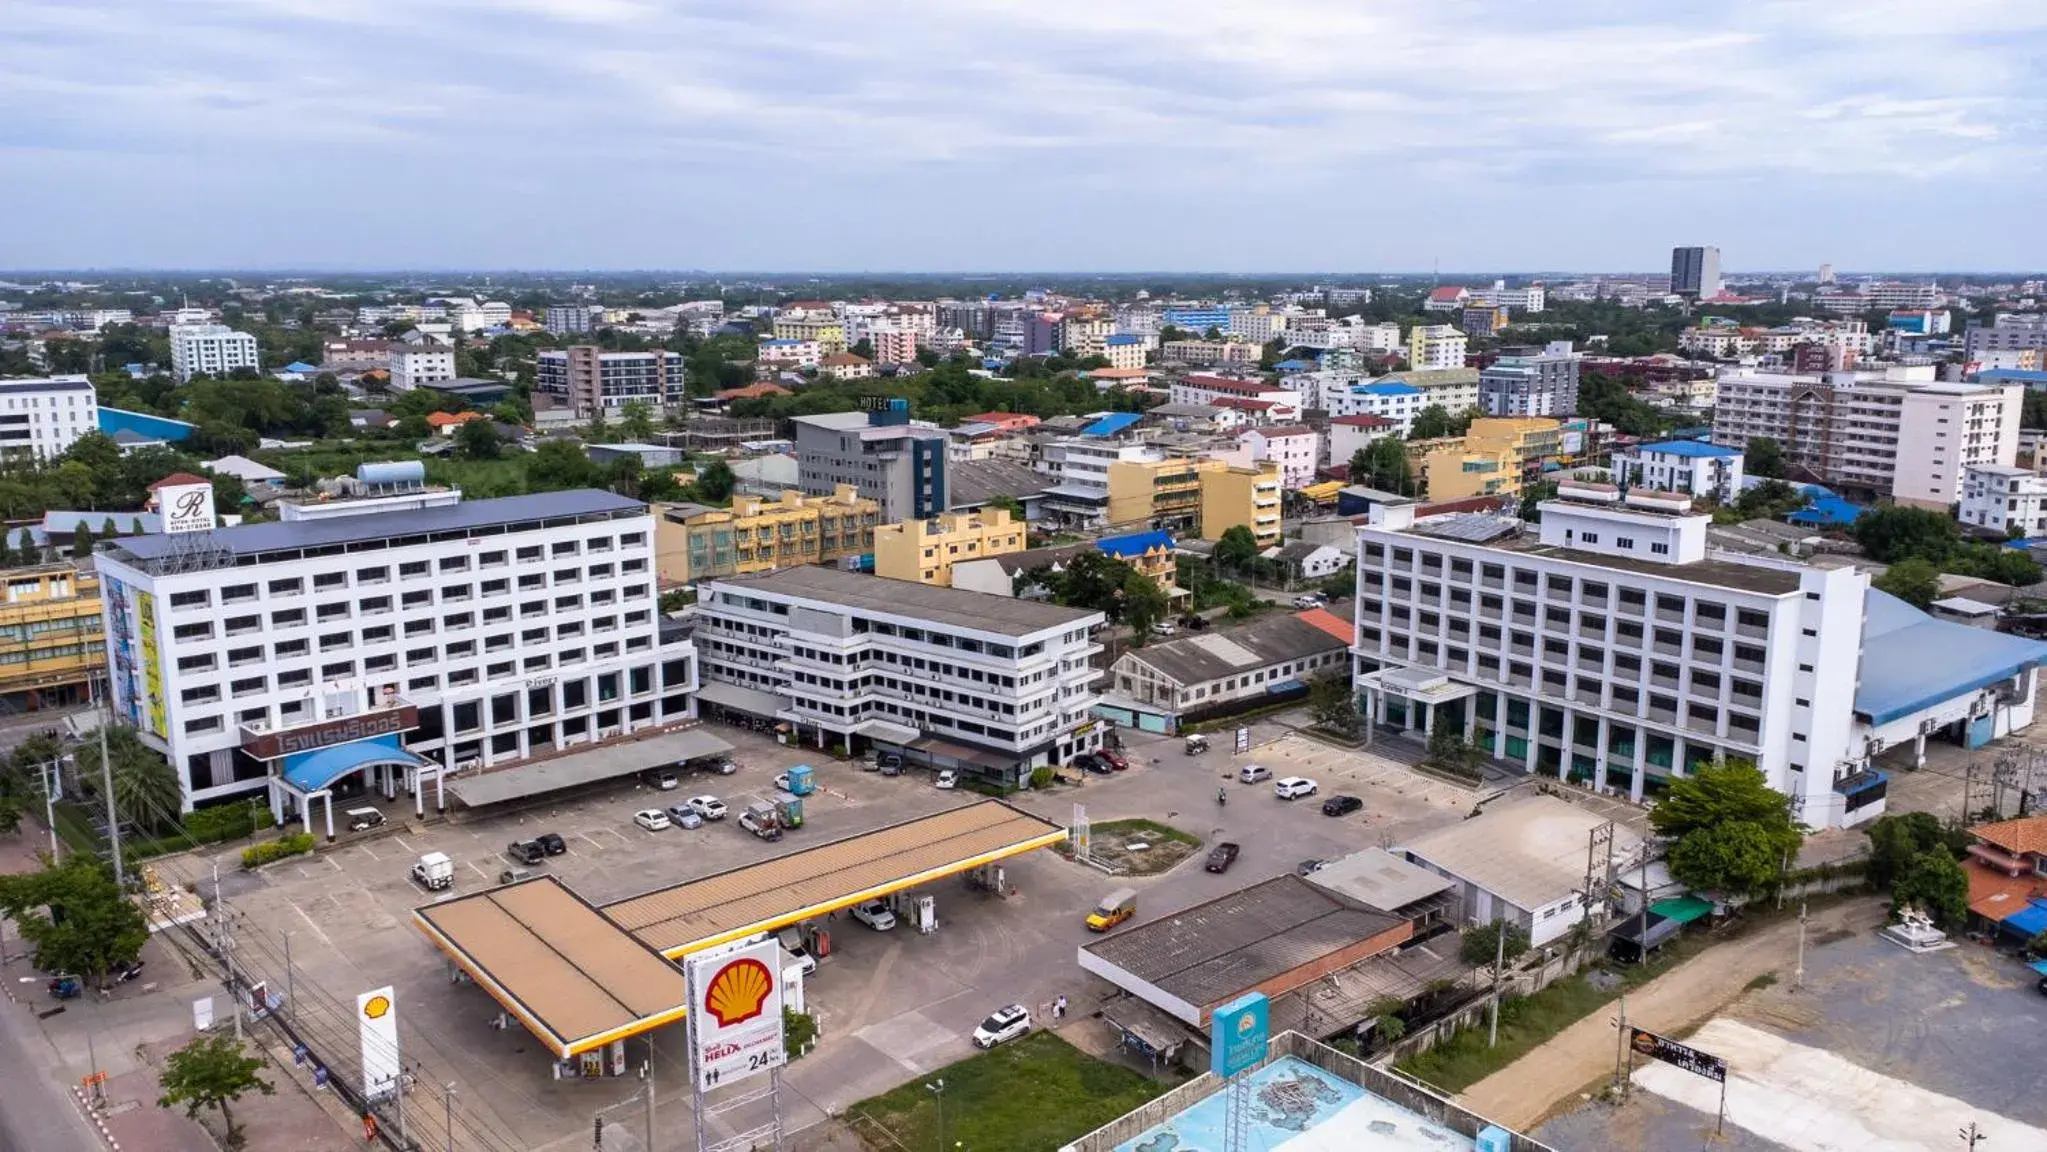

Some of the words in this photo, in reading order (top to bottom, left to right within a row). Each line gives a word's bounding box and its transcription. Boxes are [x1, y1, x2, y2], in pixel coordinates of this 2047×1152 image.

[860, 396, 889, 410] HOTEL
[171, 491, 206, 519] R
[705, 1043, 741, 1062] HELIX
[749, 1051, 769, 1071] 24
